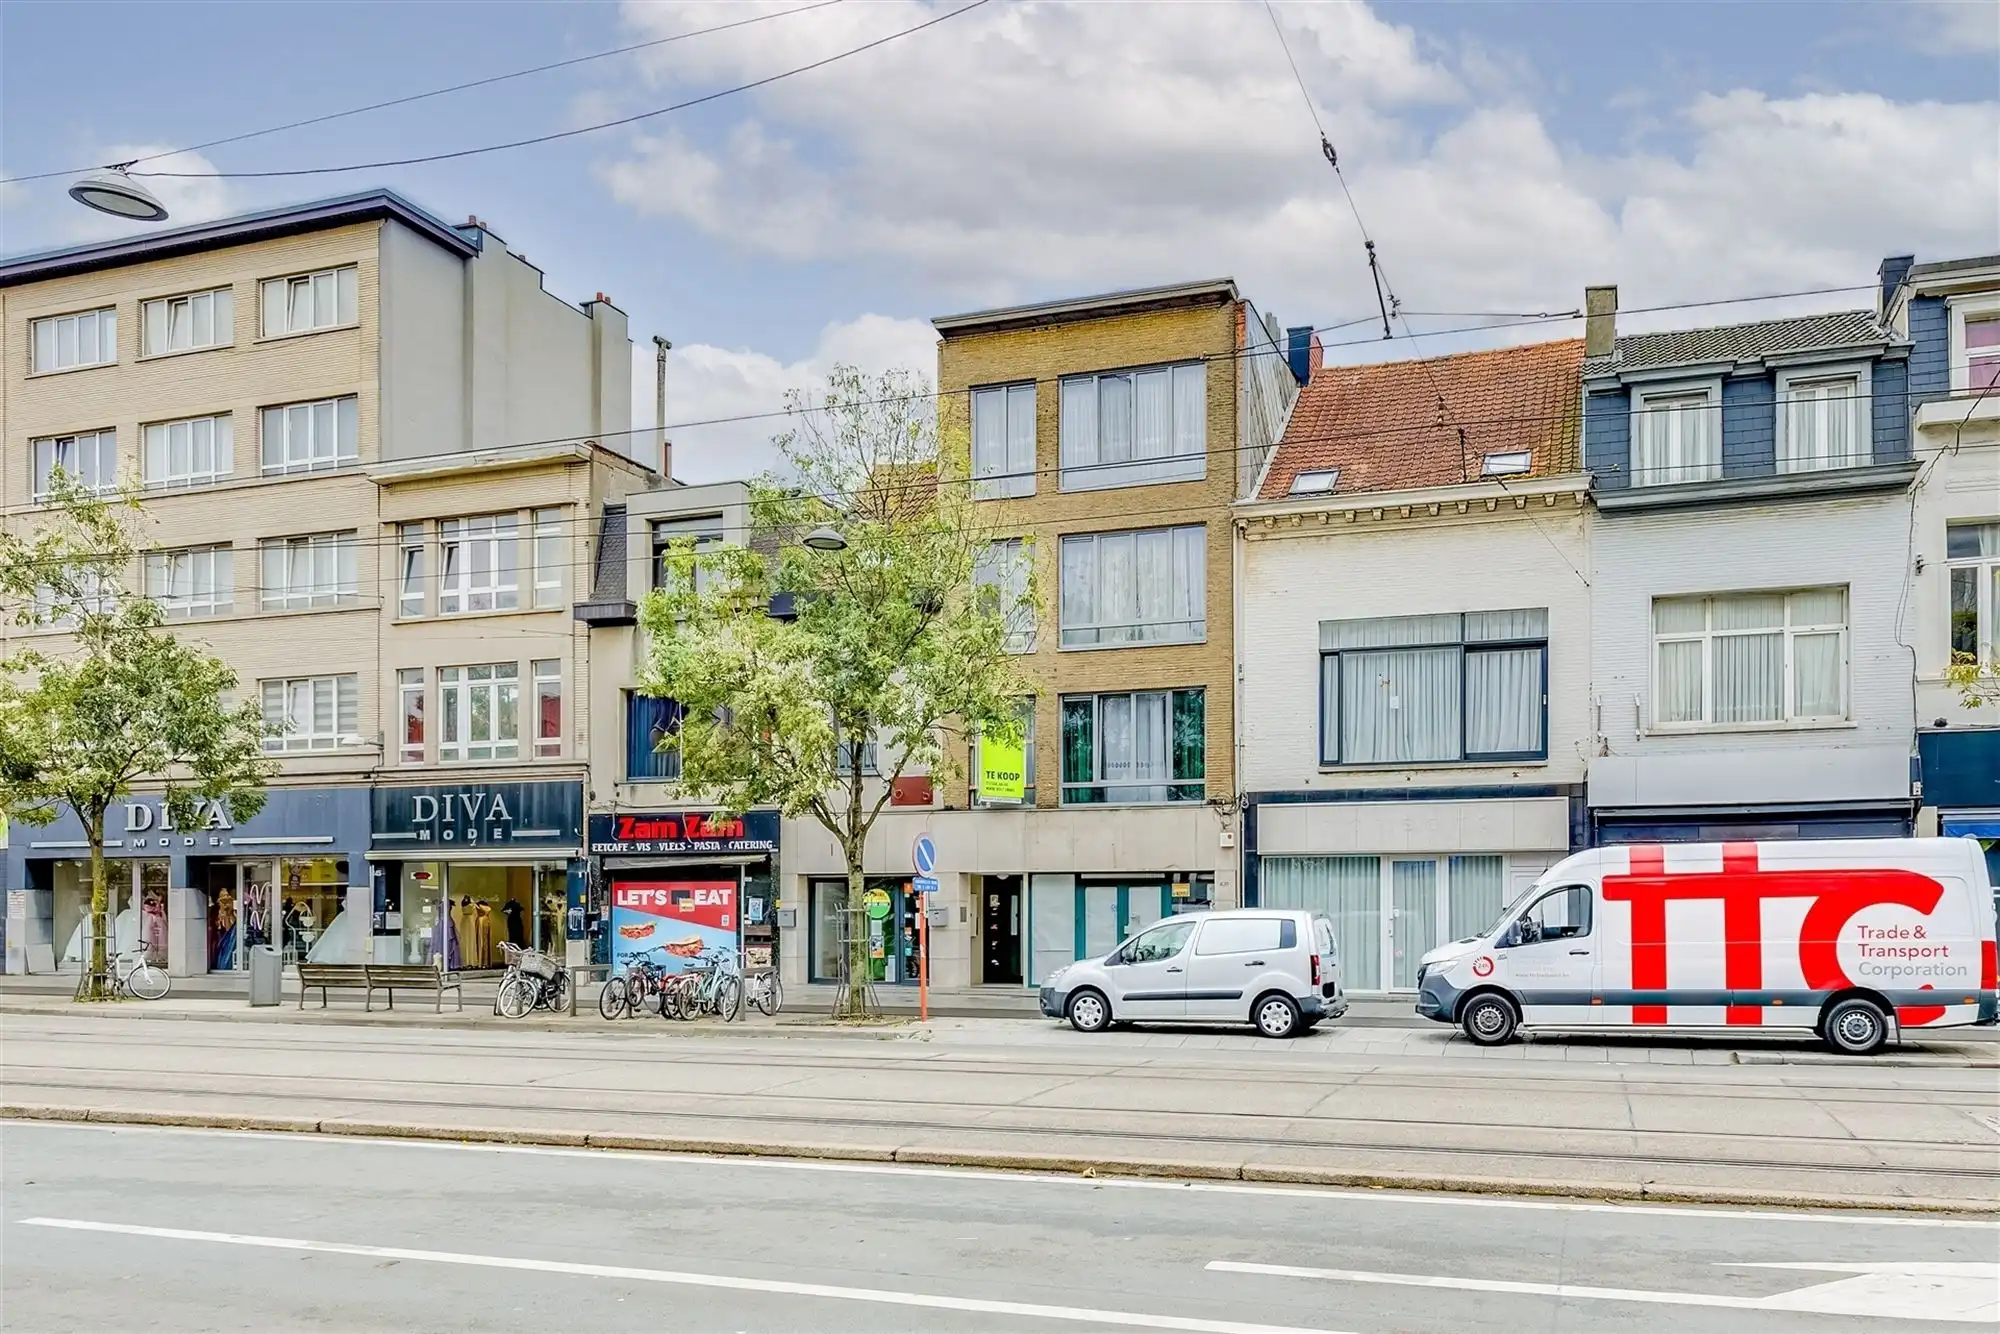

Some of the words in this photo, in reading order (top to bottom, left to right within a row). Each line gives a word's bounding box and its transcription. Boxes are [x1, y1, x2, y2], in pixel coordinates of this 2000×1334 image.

[986, 770, 995, 779] TE
[997, 771, 1021, 781] KOOP
[412, 792, 513, 823] DIVA
[419, 827, 503, 841] MODE
[618, 815, 677, 840] Zam
[133, 836, 220, 848] MODE
[592, 842, 628, 852] EETCAFE
[635, 842, 652, 851] VIS
[694, 841, 720, 851] PASTA
[728, 840, 773, 850] CATERING
[617, 889, 667, 906] LET'S
[694, 888, 732, 905] EAT
[1857, 924, 1910, 939] Trade
[1913, 925, 1927, 939] &
[1857, 943, 1949, 961] Transport
[1858, 961, 1968, 980] Corporation
